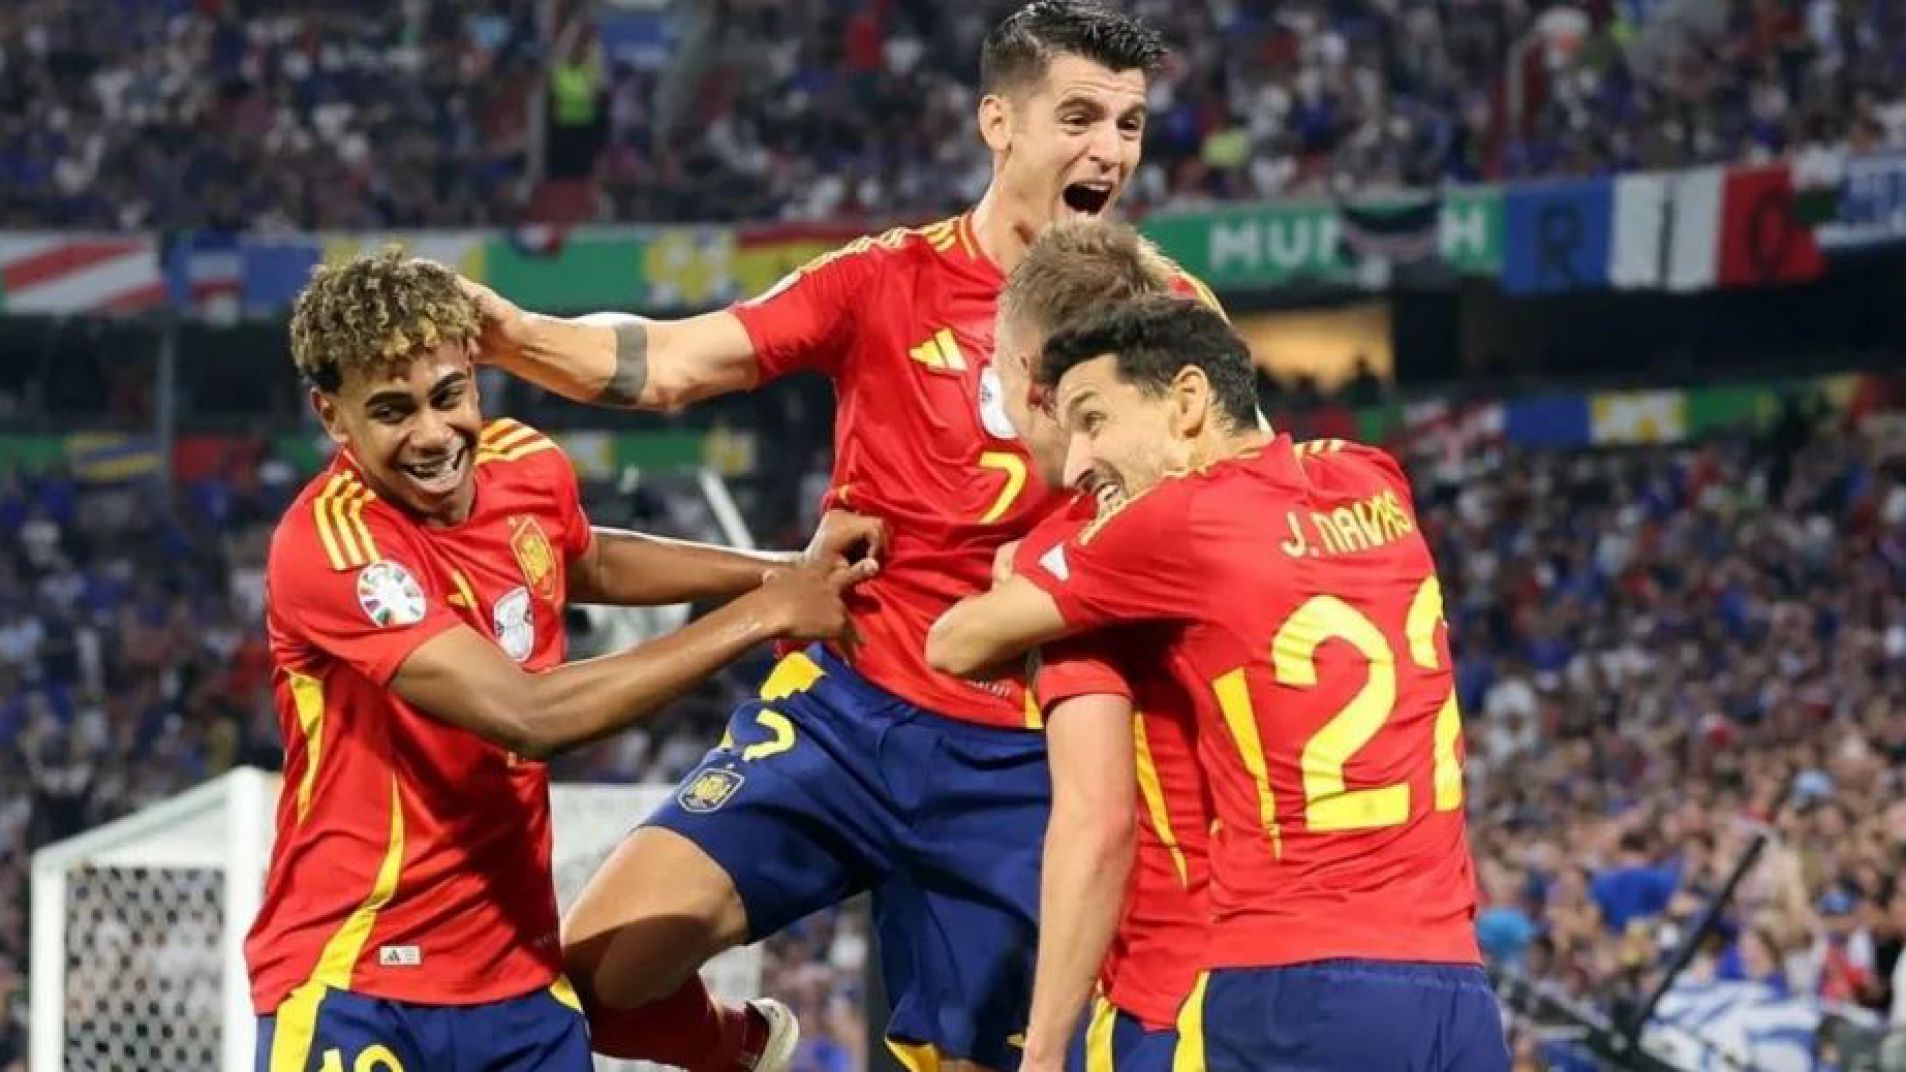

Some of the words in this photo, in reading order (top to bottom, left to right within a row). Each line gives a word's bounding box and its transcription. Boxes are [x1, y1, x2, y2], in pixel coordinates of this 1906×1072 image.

[1208, 206, 1487, 271] MUH
[979, 451, 1027, 525] 7
[1280, 511, 1320, 557] J.
